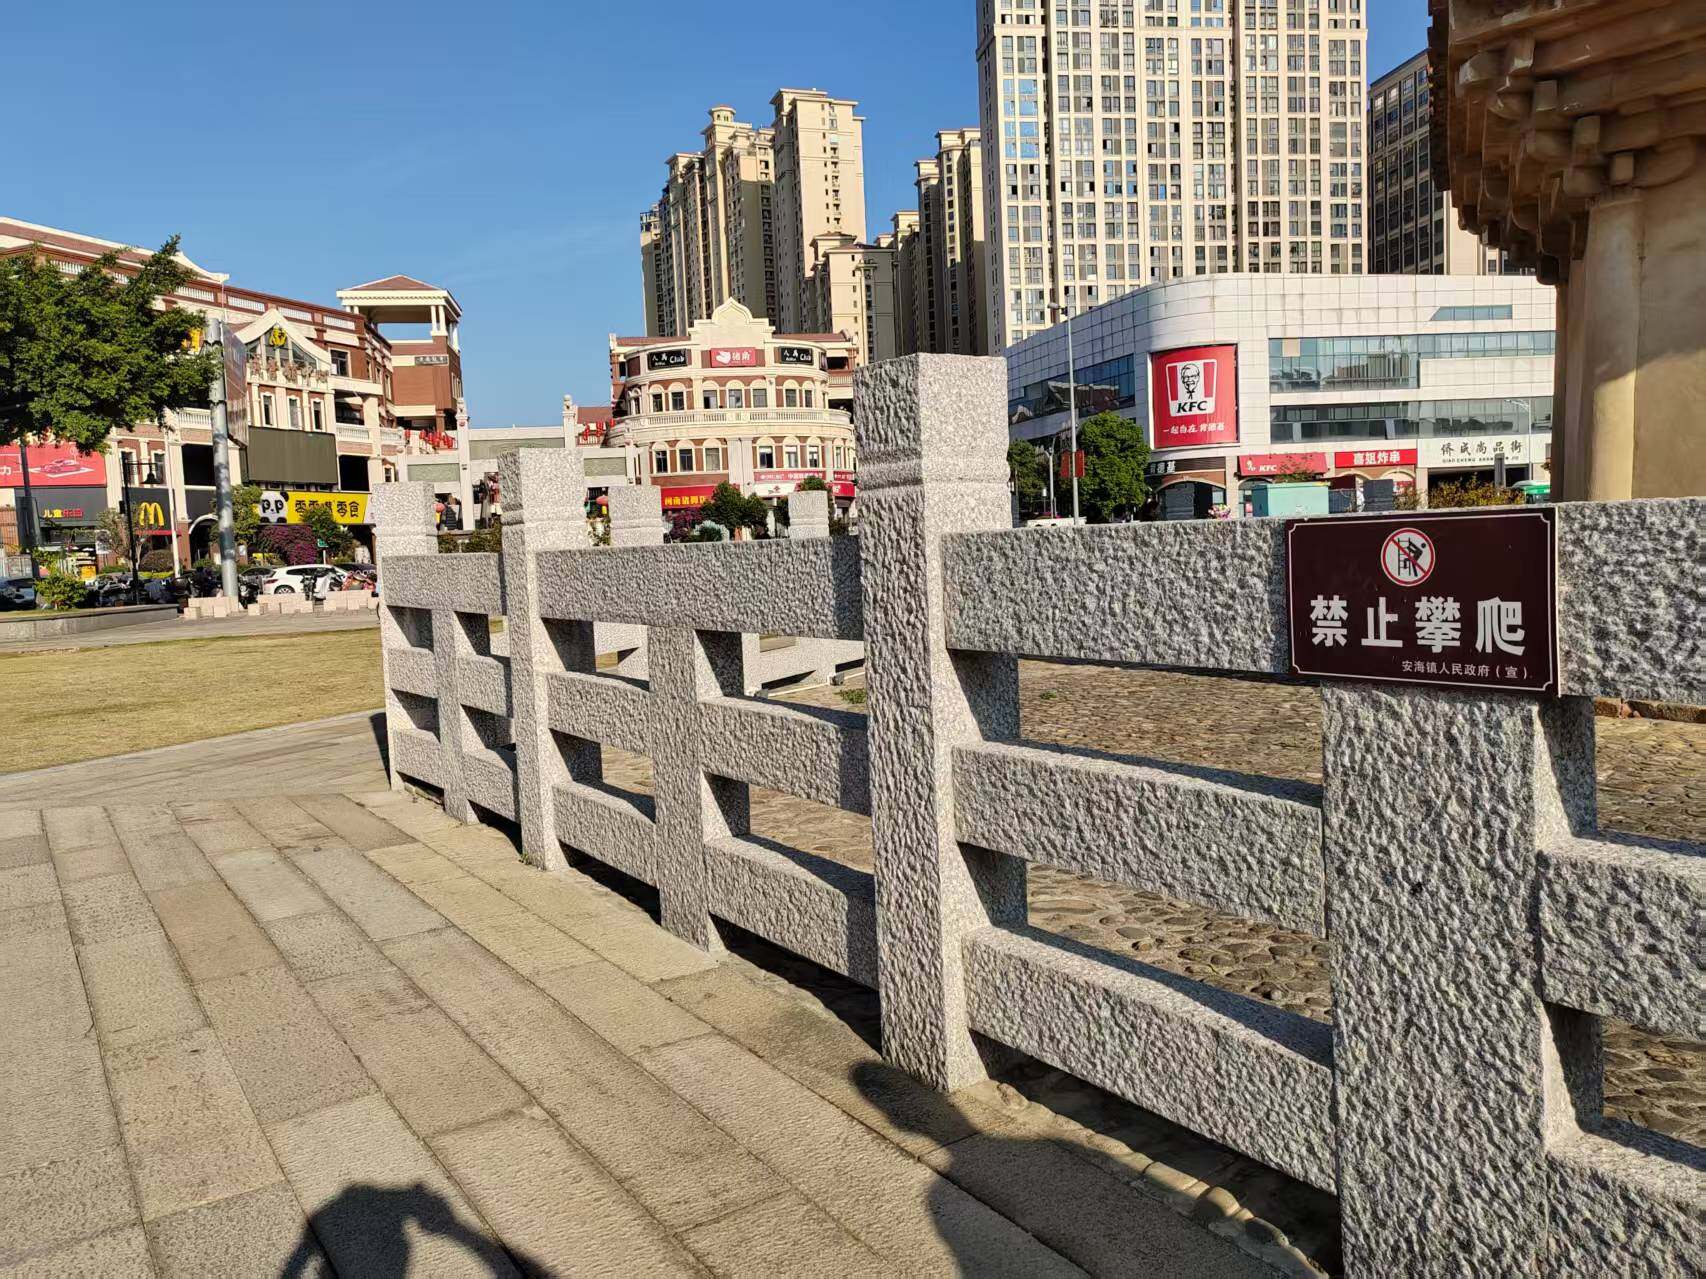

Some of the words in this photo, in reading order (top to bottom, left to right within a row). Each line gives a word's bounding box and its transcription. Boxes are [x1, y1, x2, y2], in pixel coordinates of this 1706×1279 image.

[1177, 400, 1208, 413] KFC
[1259, 464, 1278, 472] KFC
[1309, 594, 1526, 656] 禁止攀爬
